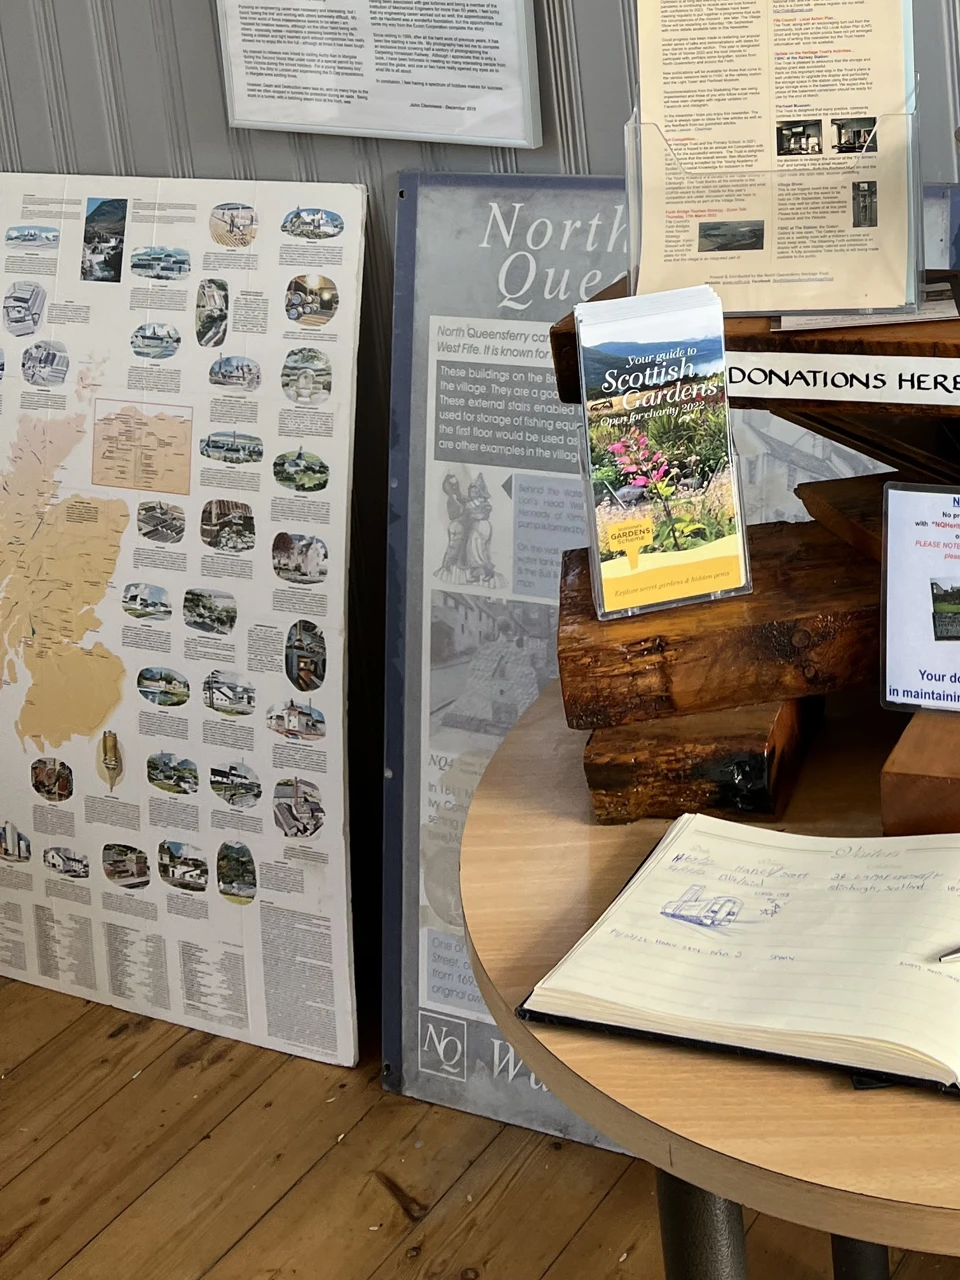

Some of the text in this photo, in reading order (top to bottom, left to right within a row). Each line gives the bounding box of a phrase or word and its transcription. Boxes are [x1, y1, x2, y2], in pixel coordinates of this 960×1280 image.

[479, 202, 627, 254] North
[497, 251, 627, 310] Que
[437, 325, 464, 337] North
[467, 327, 529, 343] Queensferry
[437, 342, 549, 359] West Fife. It is known for
[656, 348, 684, 364] guide
[688, 347, 697, 355] to
[441, 365, 465, 376] These
[469, 368, 508, 381] buildings
[528, 372, 542, 382] the
[601, 357, 695, 393] Scottish
[728, 366, 886, 388] DONATIONS
[439, 394, 574, 414] These external stairs enabled
[622, 381, 718, 410] Gardens
[600, 401, 705, 427] Open for charity 2022
[610, 527, 651, 541] GARDENS
[919, 669, 945, 681] Your
[889, 685, 898, 696] in
[831, 846, 900, 858] Visitors
[422, 1023, 462, 1073] NQ
